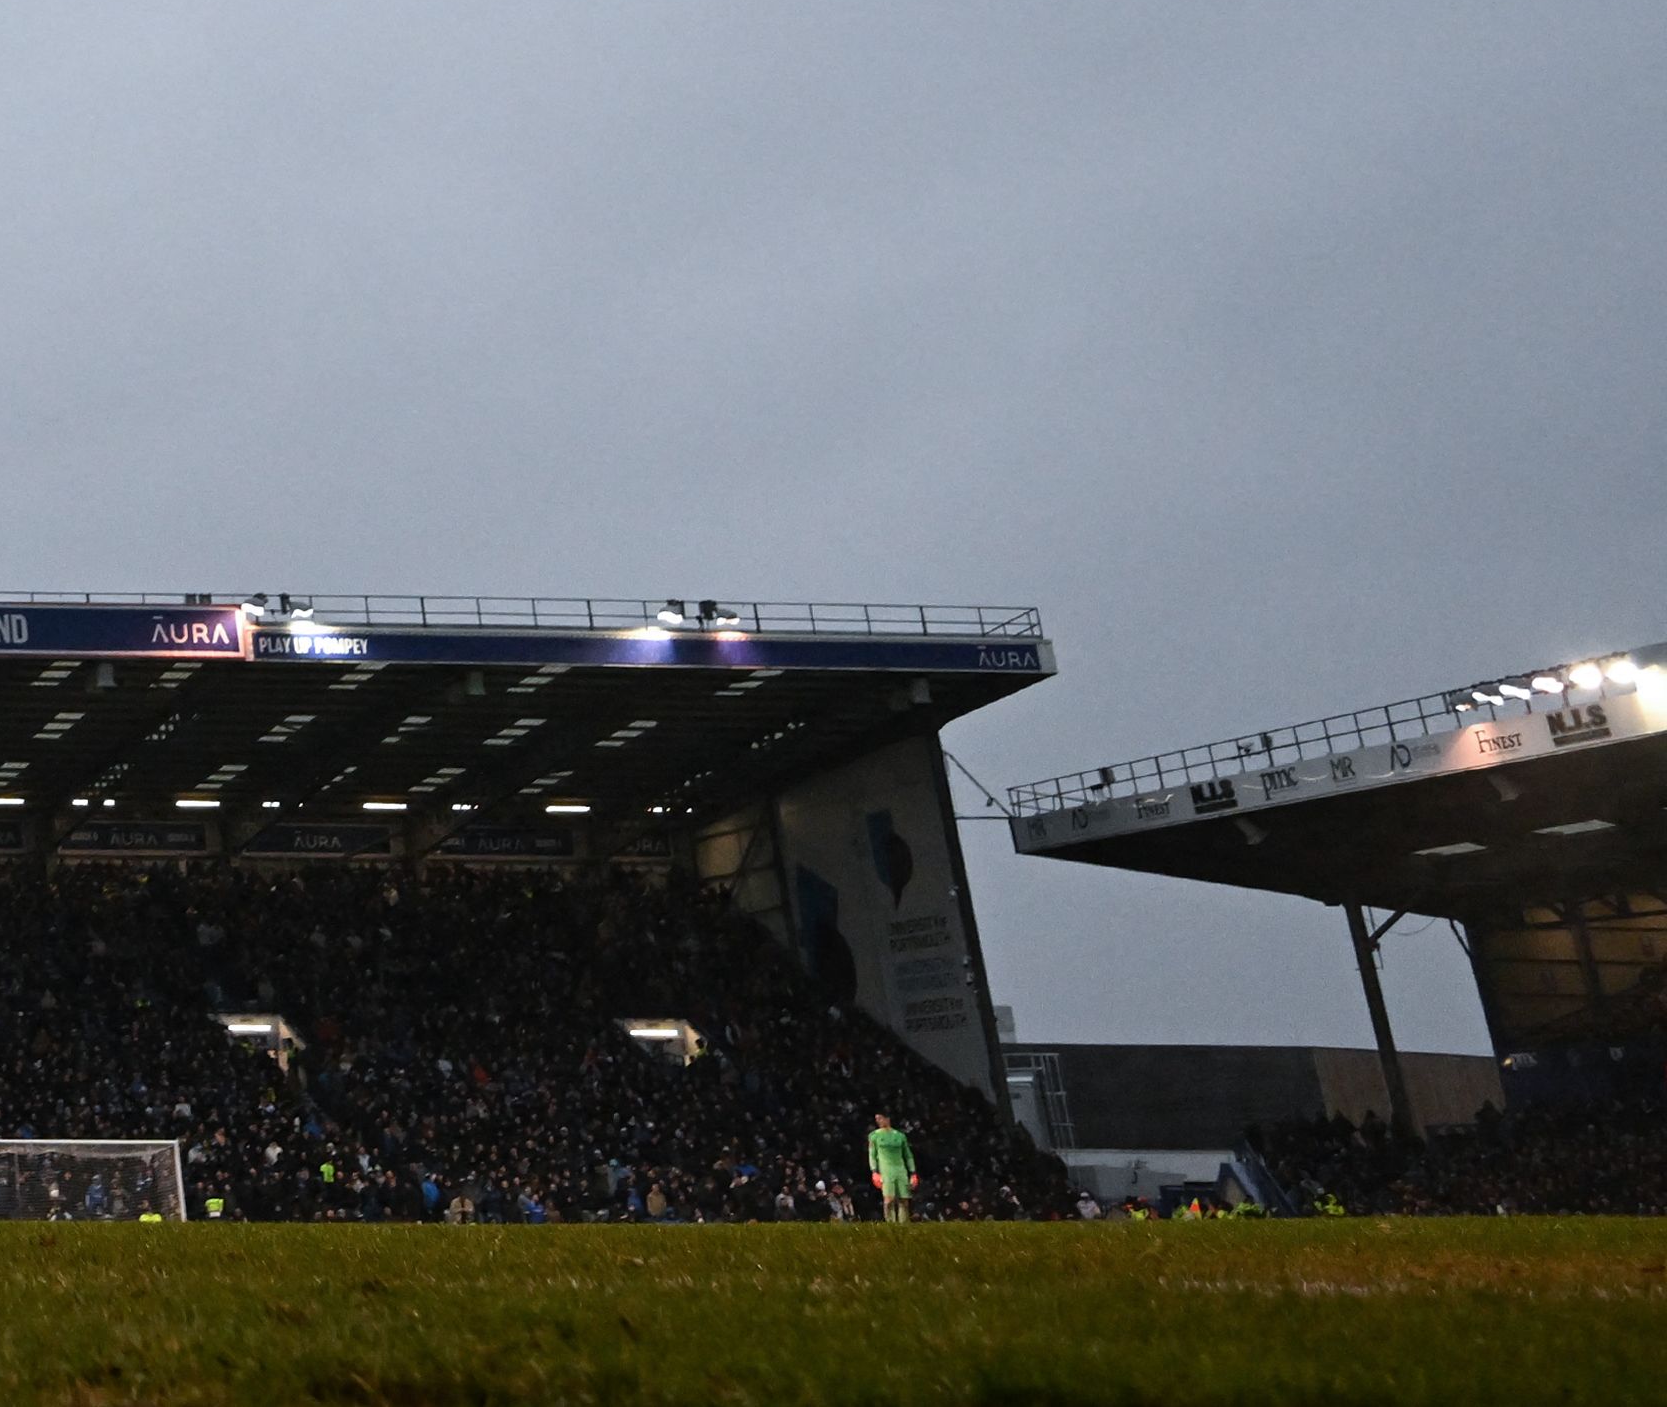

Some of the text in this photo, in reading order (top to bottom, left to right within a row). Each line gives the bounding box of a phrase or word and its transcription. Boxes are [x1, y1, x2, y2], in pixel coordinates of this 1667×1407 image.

[259, 636, 368, 655] PLAY UP POMPEY
